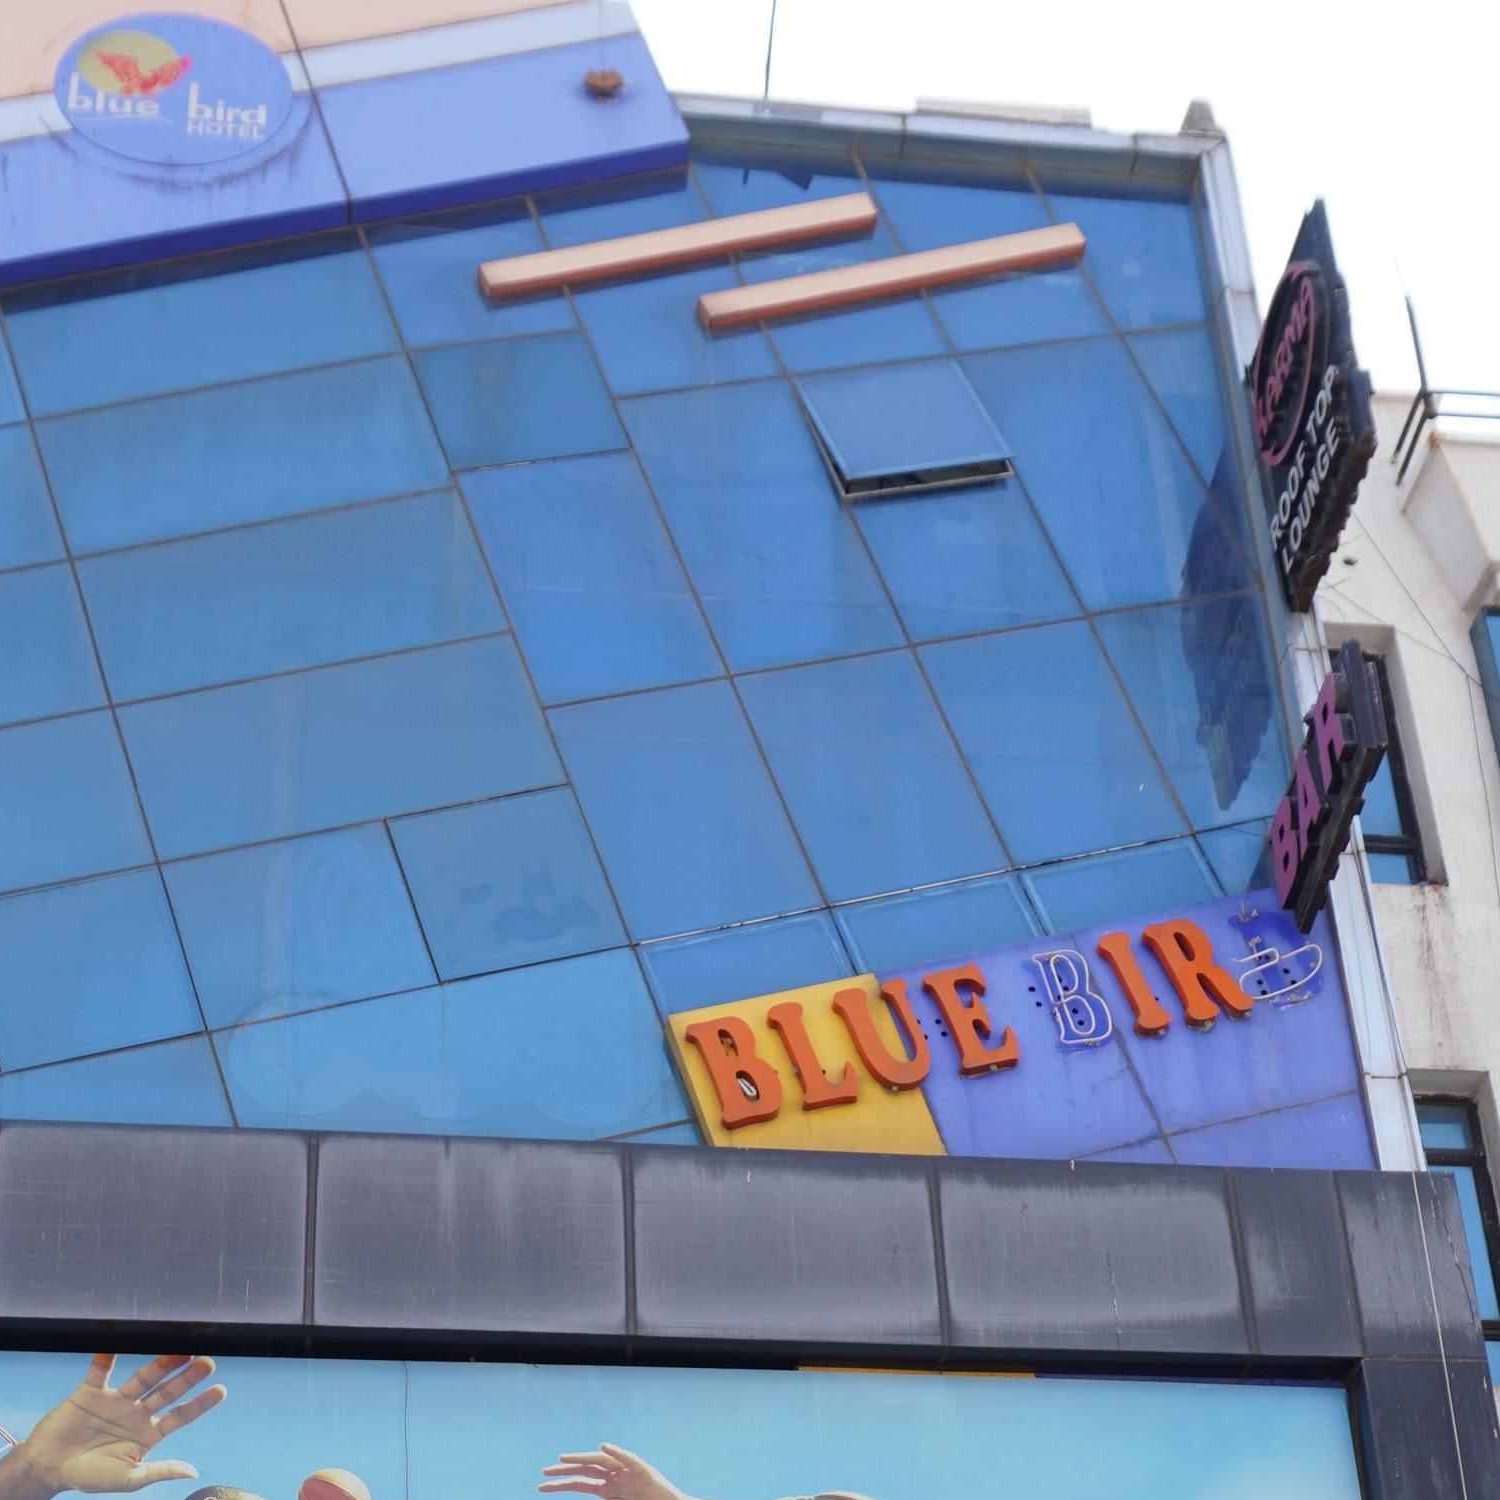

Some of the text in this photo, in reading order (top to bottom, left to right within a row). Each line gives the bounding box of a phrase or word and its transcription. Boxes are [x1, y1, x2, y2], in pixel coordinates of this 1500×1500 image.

[67, 71, 267, 126] blue bird
[186, 119, 266, 141] HOTEL
[1269, 363, 1338, 551] ROOF TOP
[1281, 420, 1341, 575] LOUNGE
[1270, 674, 1347, 903] BAR
[686, 963, 1020, 1131] BLUE
